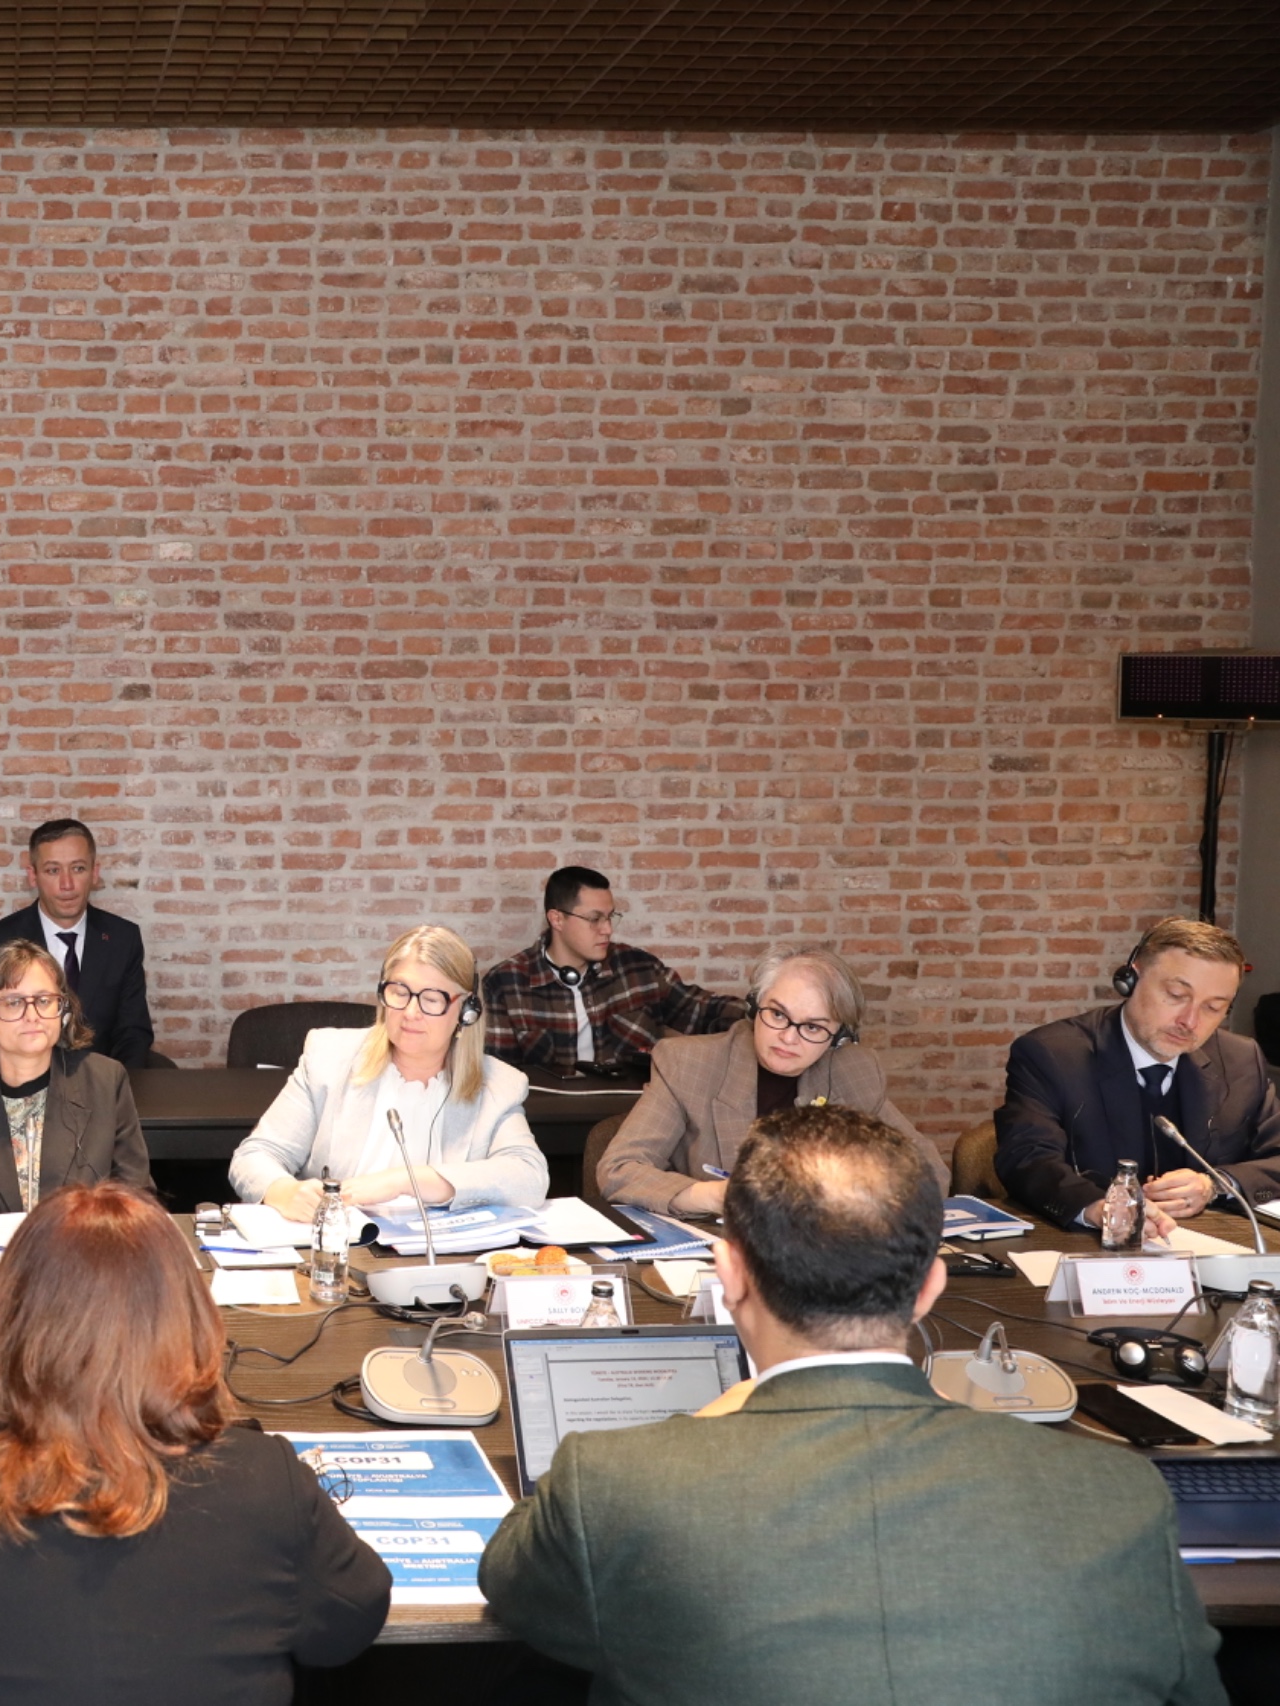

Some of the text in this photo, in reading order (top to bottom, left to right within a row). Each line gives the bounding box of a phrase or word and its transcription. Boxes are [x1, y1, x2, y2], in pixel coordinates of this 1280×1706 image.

[548, 1306, 568, 1314] SALLY
[334, 1455, 402, 1465] COP31
[376, 1536, 451, 1546] COP31
